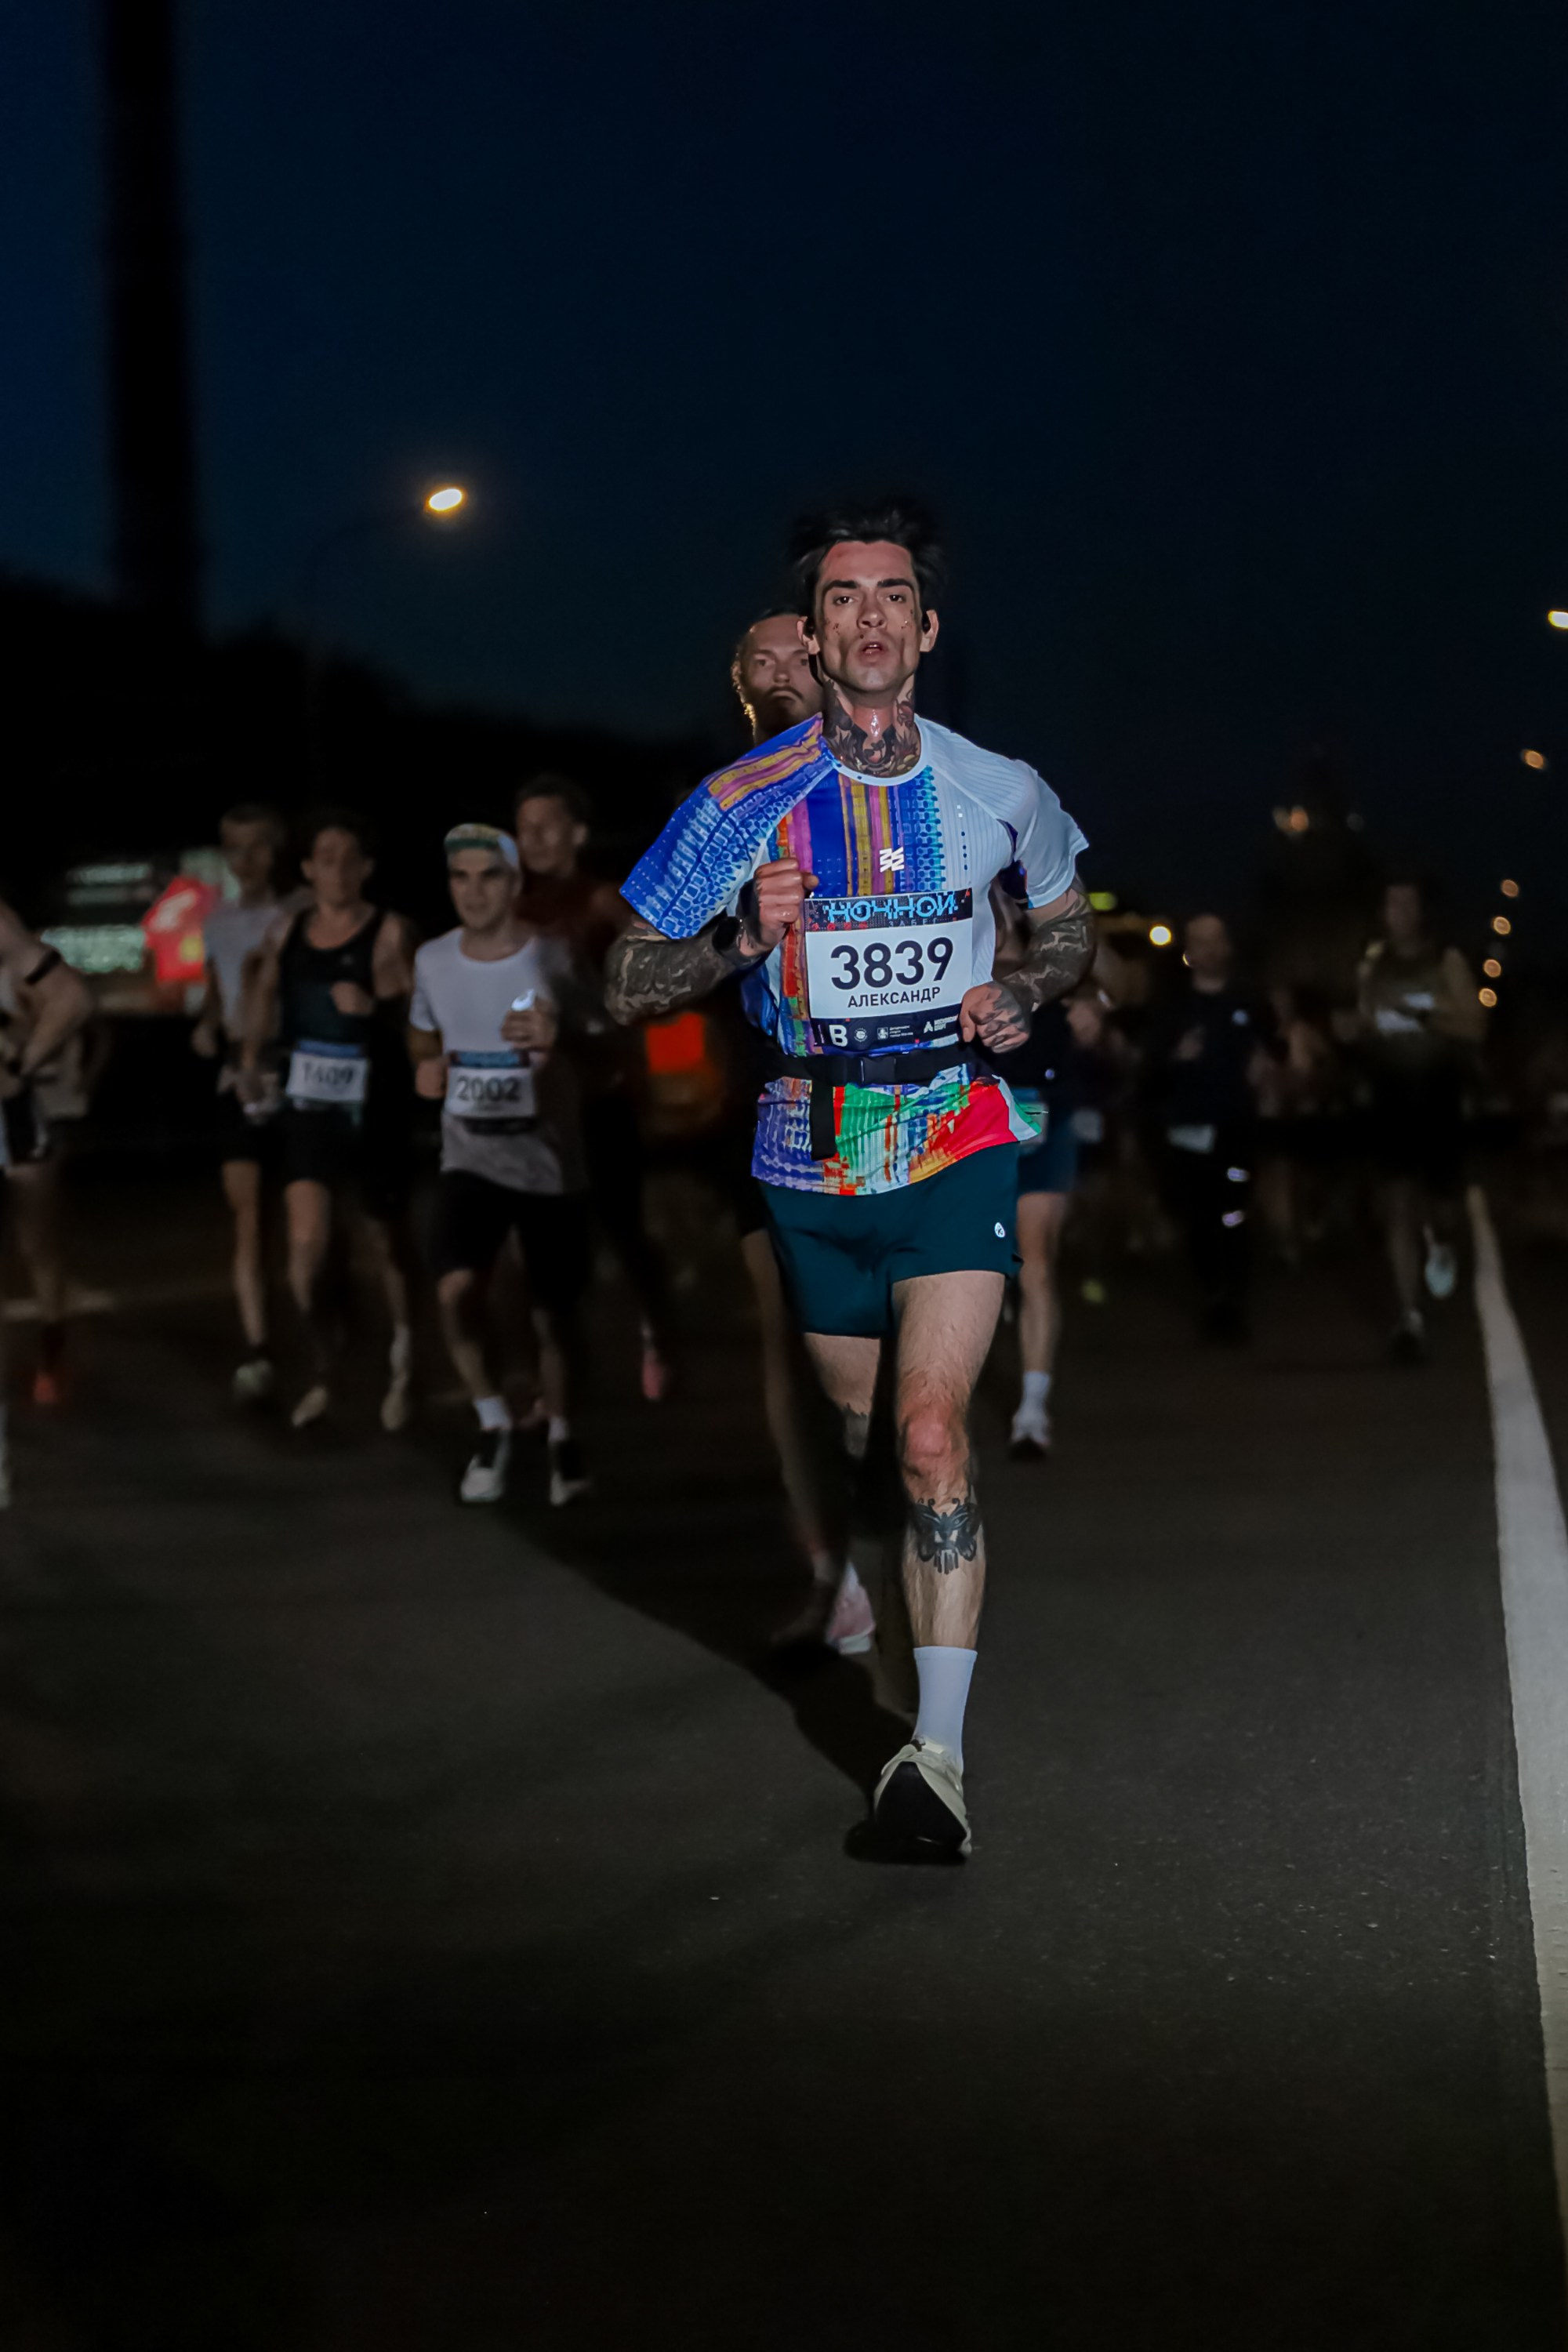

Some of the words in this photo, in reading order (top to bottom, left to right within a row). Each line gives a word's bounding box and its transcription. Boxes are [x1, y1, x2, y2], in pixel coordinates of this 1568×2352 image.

[829, 937, 953, 990] 3839
[848, 987, 941, 1008] АЛЕКСАНДР
[456, 1076, 521, 1102] 2002
